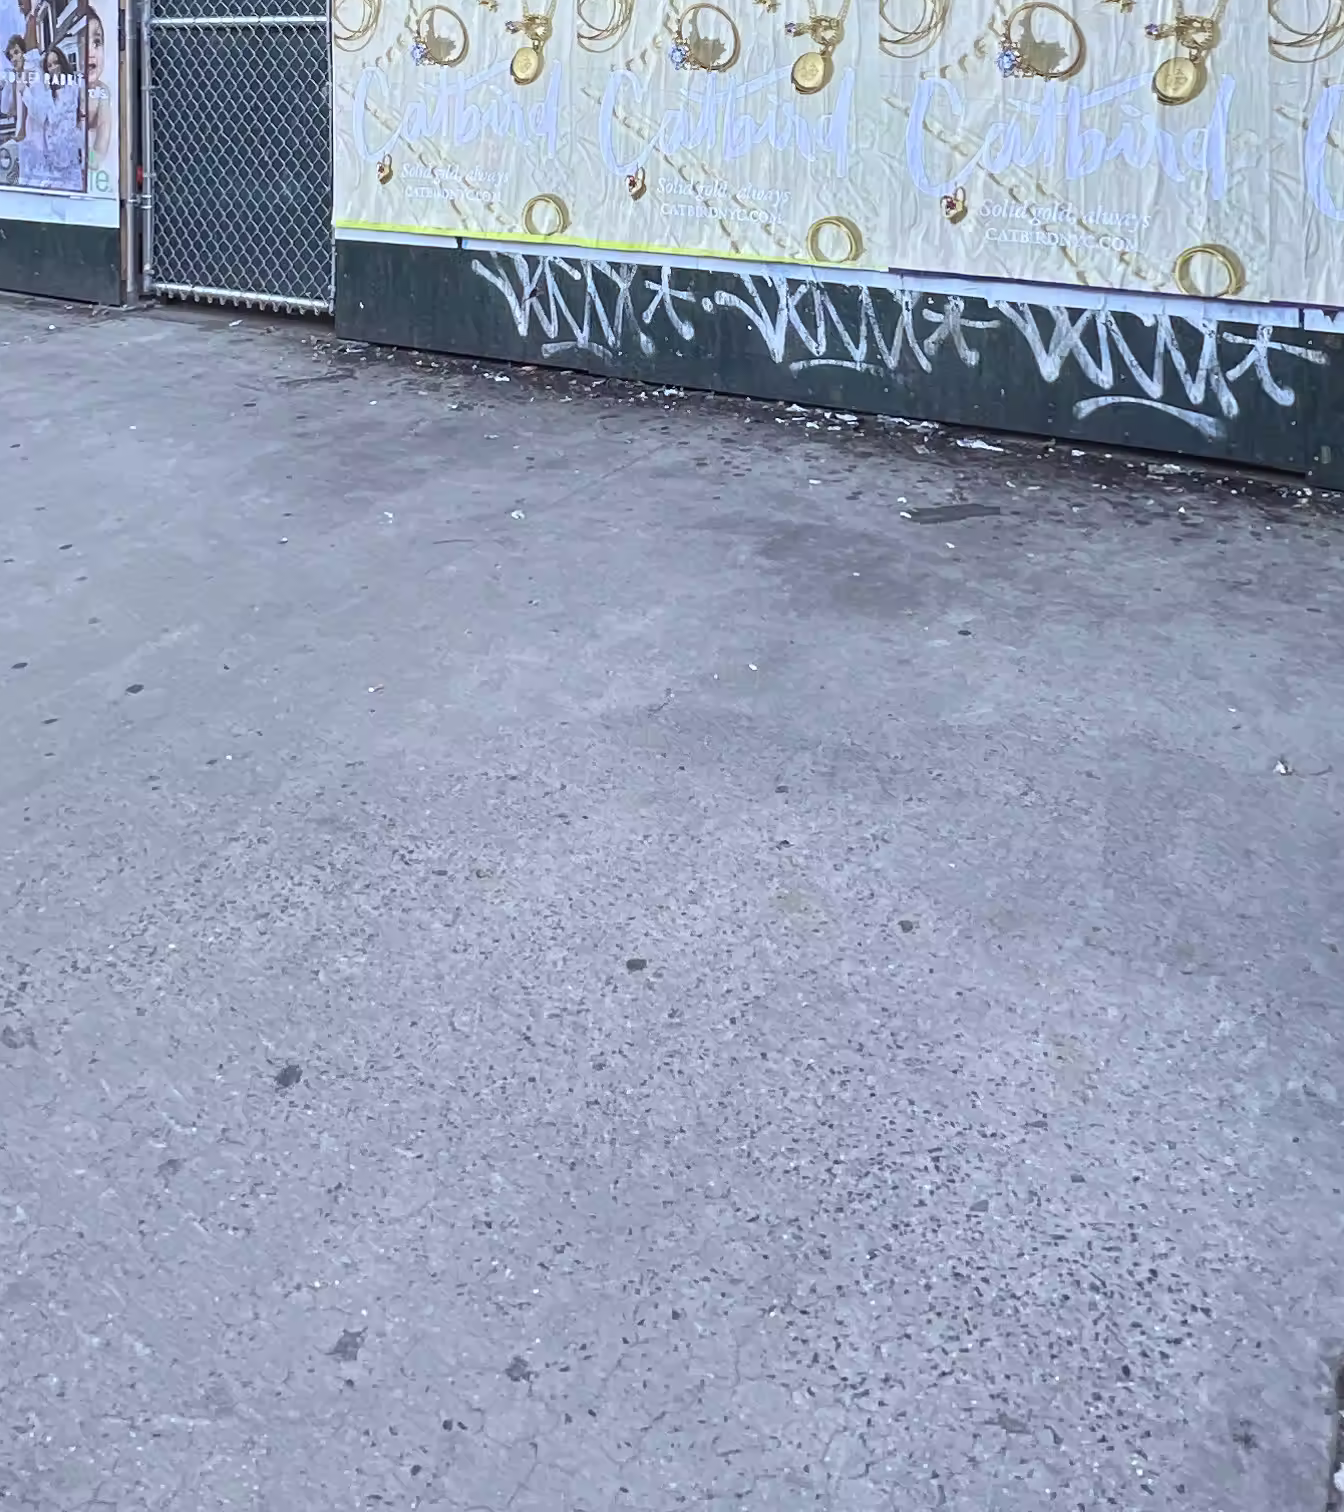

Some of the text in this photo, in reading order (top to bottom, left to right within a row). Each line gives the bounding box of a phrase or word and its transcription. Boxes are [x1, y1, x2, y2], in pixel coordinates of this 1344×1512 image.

[352, 58, 562, 163] Catbird
[599, 66, 855, 178] Catbird
[906, 71, 1236, 201] Catbird
[656, 177, 695, 197] Solid
[735, 183, 792, 208] always
[979, 199, 1152, 234] Solid gold, always
